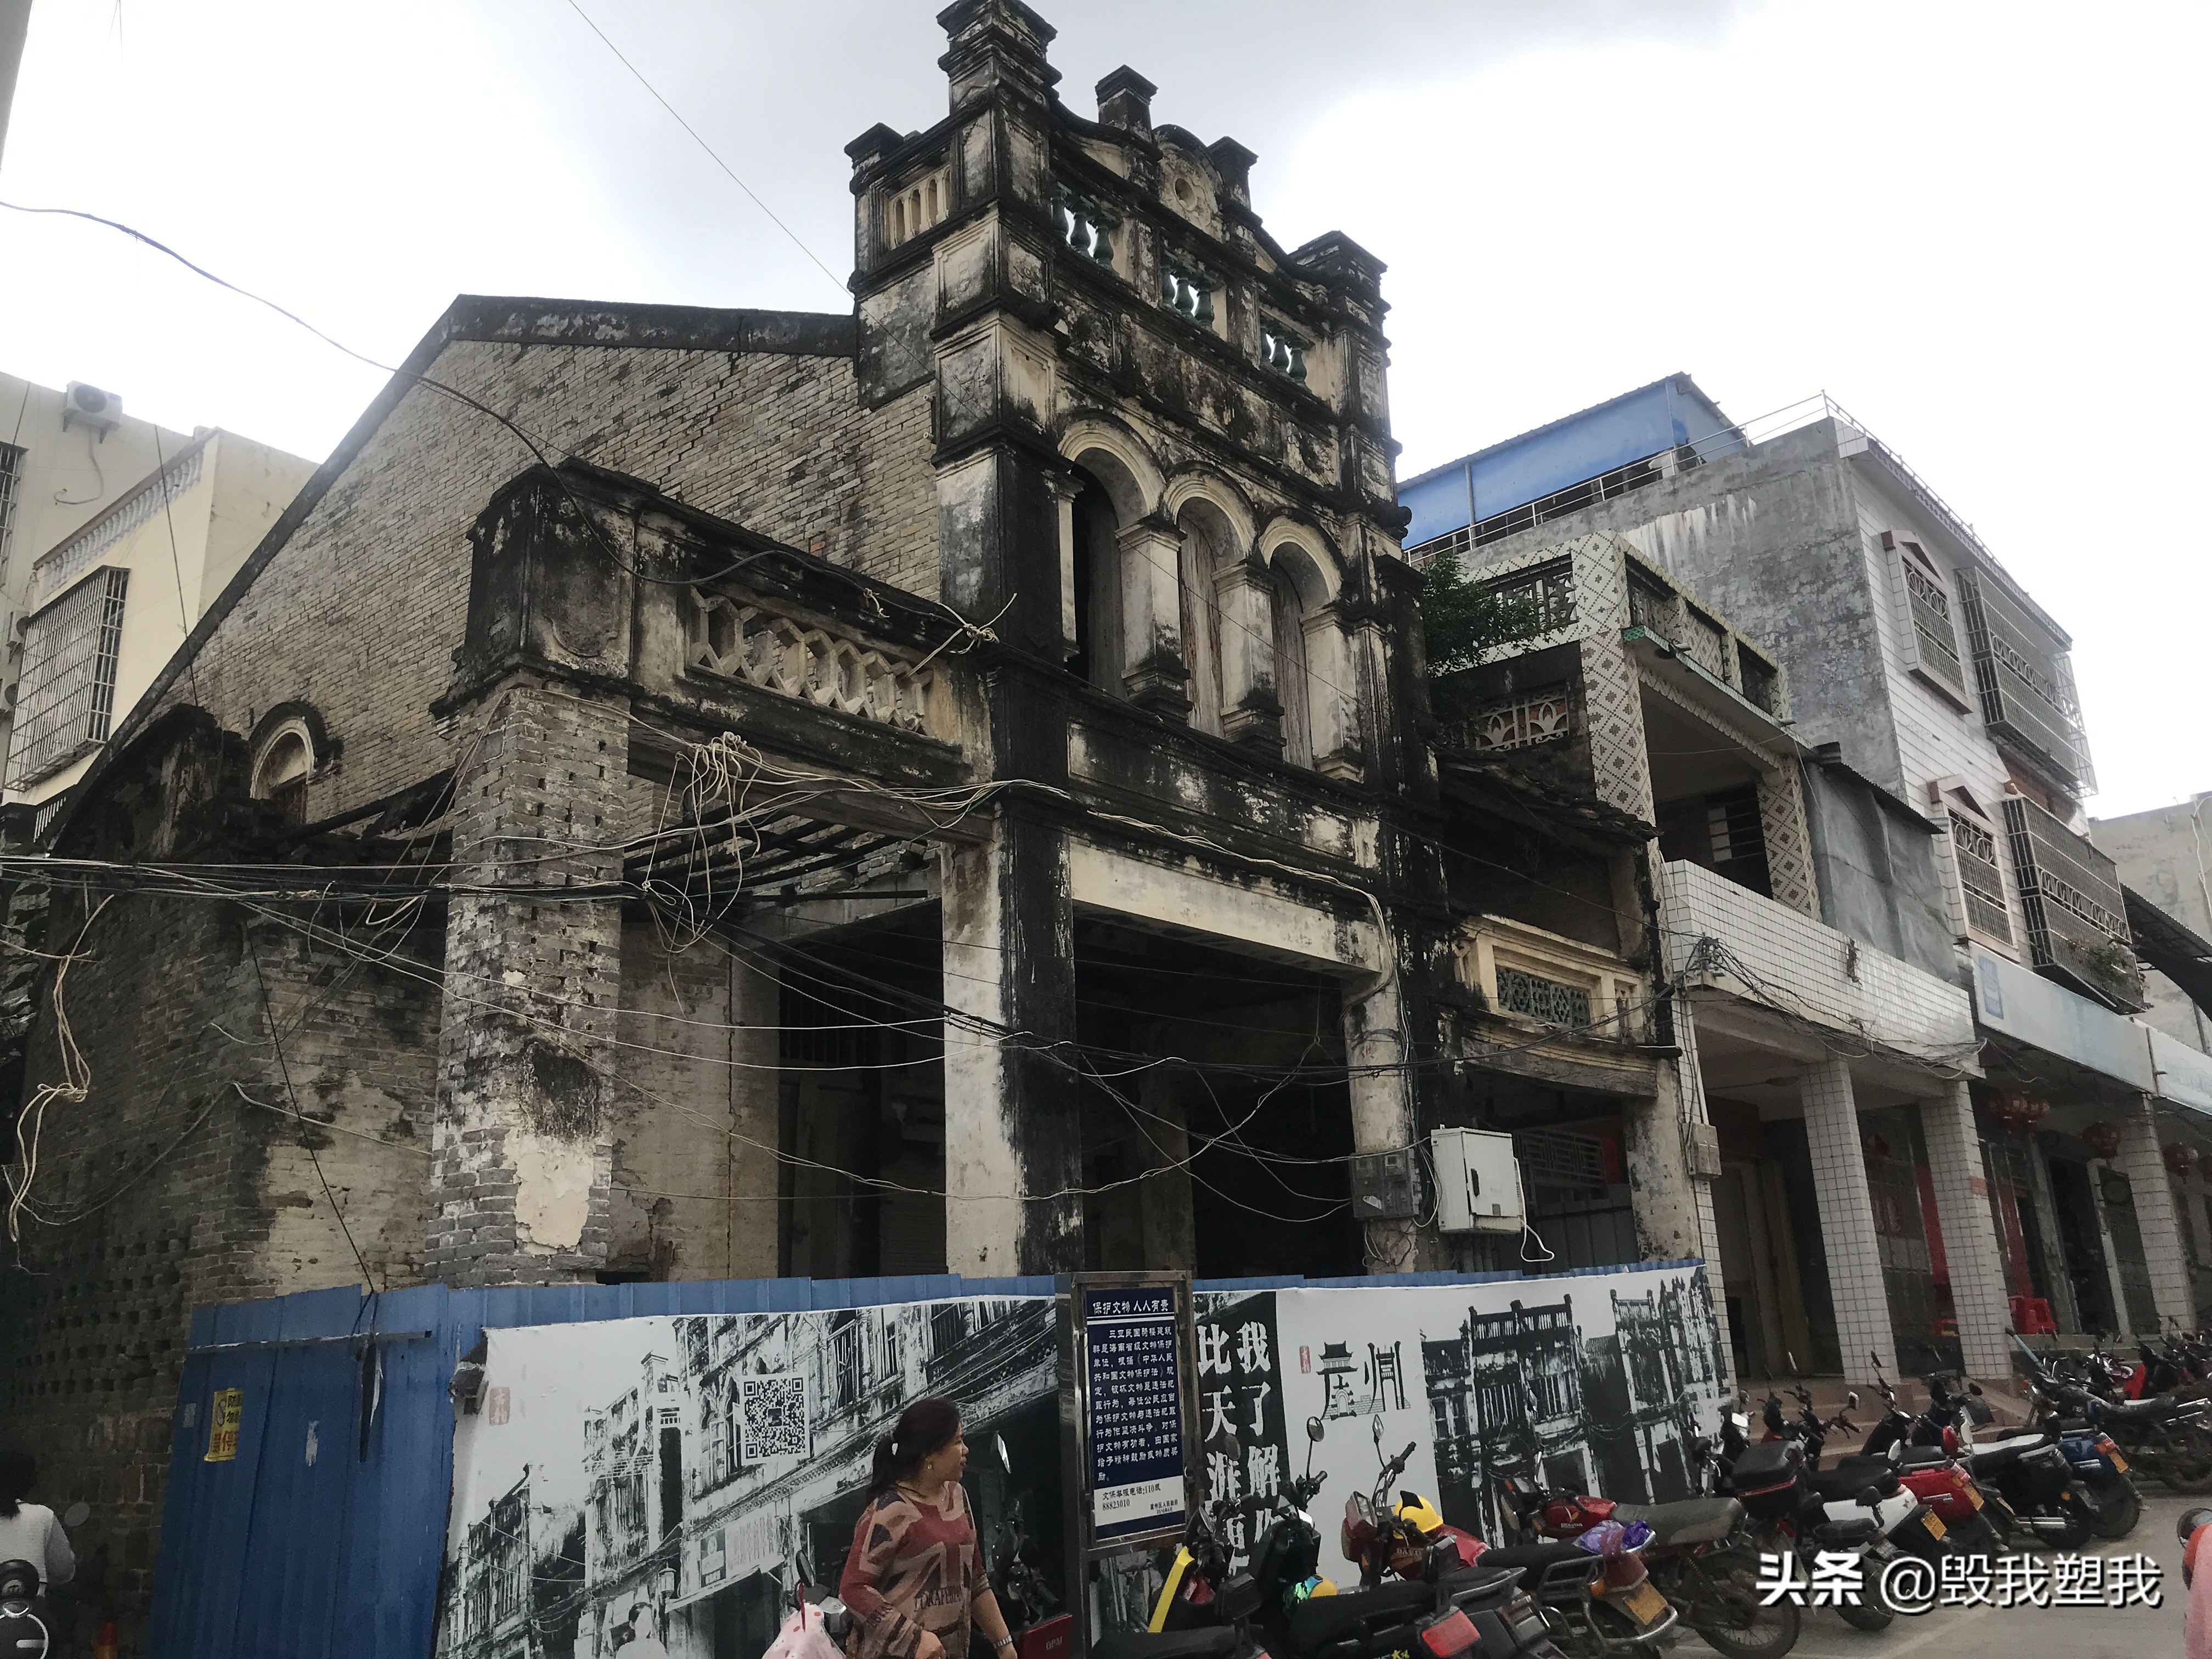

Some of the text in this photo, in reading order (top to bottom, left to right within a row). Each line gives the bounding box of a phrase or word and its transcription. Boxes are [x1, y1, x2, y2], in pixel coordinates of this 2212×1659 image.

[1092, 1299, 1169, 1314] 保护文物 人人有责
[1109, 1326, 1172, 1339] 三亚民国骑楼建筑
[1093, 1340, 1172, 1354] 群是海南省级文物保护
[1096, 1406, 1176, 1424] 为保护文物与违法犯罪
[1097, 1446, 1178, 1468] 给予精神鼓励或物质奖
[1102, 1499, 1130, 1511] 88823010
